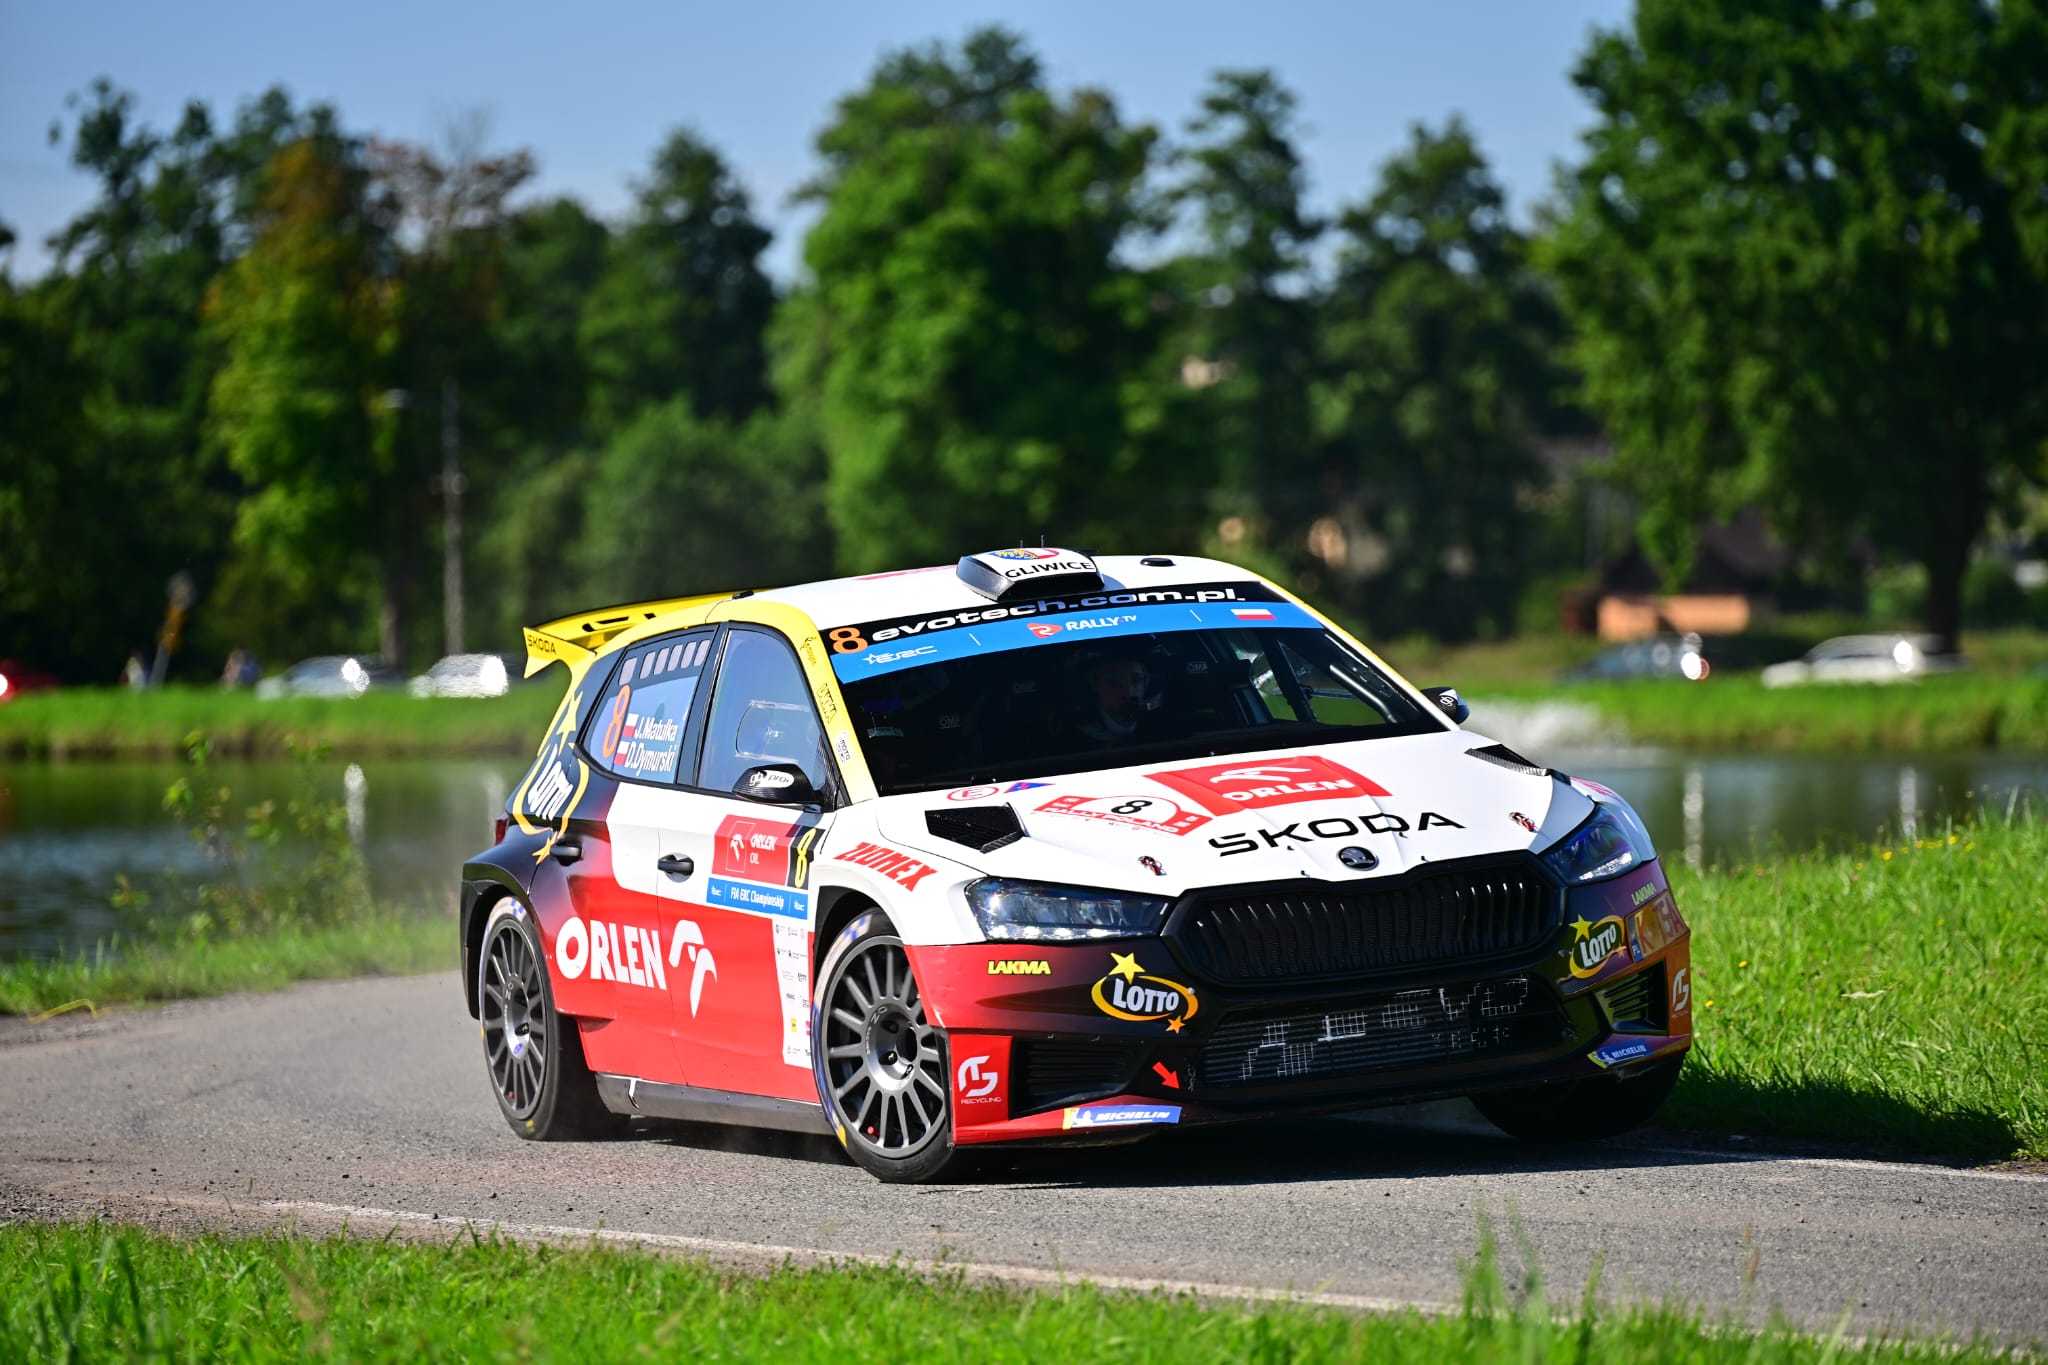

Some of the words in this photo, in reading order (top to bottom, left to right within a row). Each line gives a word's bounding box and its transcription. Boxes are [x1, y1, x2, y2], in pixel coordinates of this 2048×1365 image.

[1005, 560, 1095, 580] GLIWICE
[828, 626, 869, 654] 8
[602, 685, 631, 759] 8
[624, 741, 678, 777] D.Dymurski
[1221, 778, 1356, 802] ORLEN
[1111, 799, 1152, 815] 8
[749, 833, 779, 852] ORLEN
[749, 852, 760, 865] OIL
[795, 828, 817, 888] 8
[555, 916, 667, 990] ORLEN
[1579, 924, 1617, 968] LOTTO
[987, 960, 1052, 976] LAKMA
[1112, 978, 1180, 1013] LOTTO
[1611, 1043, 1647, 1059] MICHELIN
[960, 1096, 1003, 1105] RECYCLING
[1095, 1111, 1171, 1122] MICHELIN
